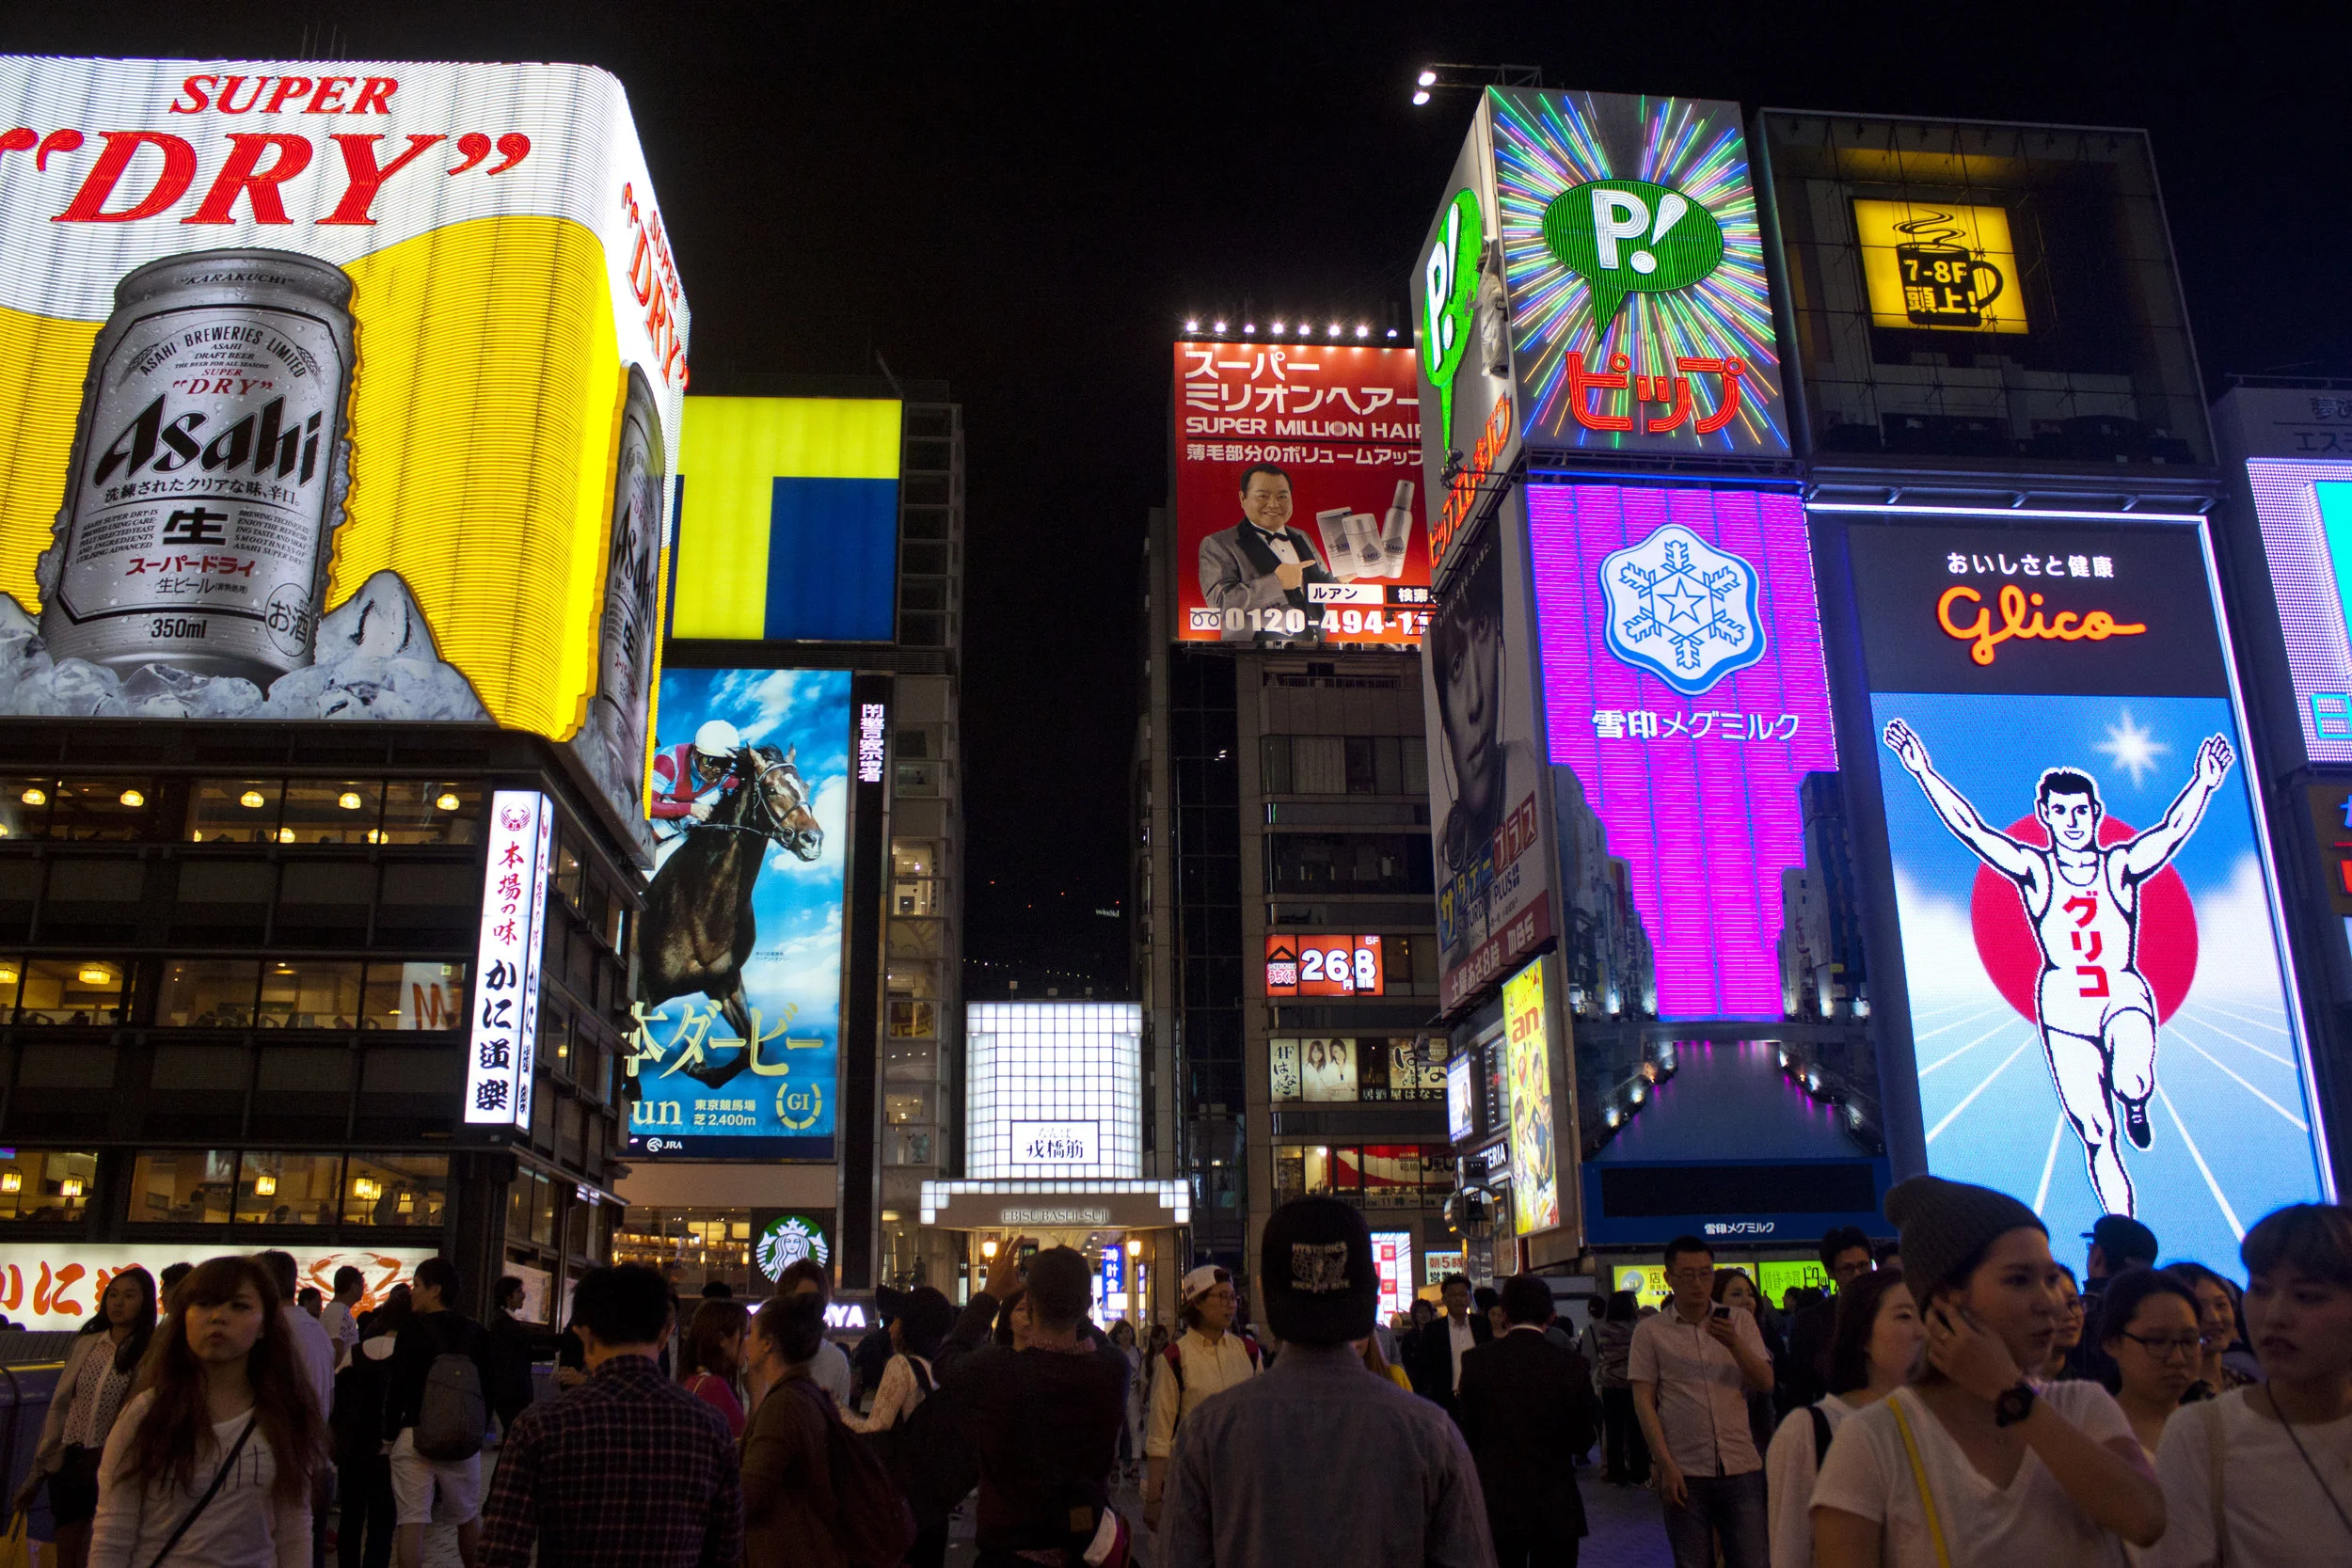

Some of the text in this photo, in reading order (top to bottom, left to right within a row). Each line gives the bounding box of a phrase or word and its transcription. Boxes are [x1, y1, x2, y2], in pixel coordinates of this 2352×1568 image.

[169, 74, 399, 114] SUPER
[1591, 189, 1688, 275] P!
[1904, 260, 1967, 283] 7-8F
[1906, 286, 1979, 314] 頭上!
[141, 326, 307, 377] ASAHI BREWERIES LIMITED
[201, 368, 243, 376] SUPER
[1185, 351, 1320, 381] スーパー
[172, 378, 274, 396] “DRY”
[1185, 383, 1420, 415] ミリオンヘアー
[1565, 351, 1745, 435] ピップ
[94, 392, 323, 487] Asahi
[1185, 417, 1267, 436] SUPER
[1276, 420, 1364, 438] MILLION
[104, 477, 301, 508] 洗練されたクリアな味、辛口。
[162, 507, 229, 546] 生
[125, 555, 256, 577] スーパードライ
[1947, 552, 2115, 579] おいしさと健康
[1312, 587, 1429, 603] ルアン 検索
[151, 619, 207, 639] 350ml
[1937, 584, 2146, 665] Glico
[1592, 709, 1800, 741] 雪印メグミルク
[492, 840, 524, 946] 本場の味
[2061, 890, 2110, 998] グリコ
[1513, 1006, 1539, 1043] an
[1275, 1046, 1295, 1059] 4F
[694, 1099, 756, 1112] 東京競馬場
[787, 1093, 810, 1111] GI
[693, 1113, 706, 1126] 芝
[663, 1140, 683, 1149] JRA
[1025, 1139, 1083, 1158] 戎橋筋
[1704, 1223, 1774, 1235] 雪印メグミルク
